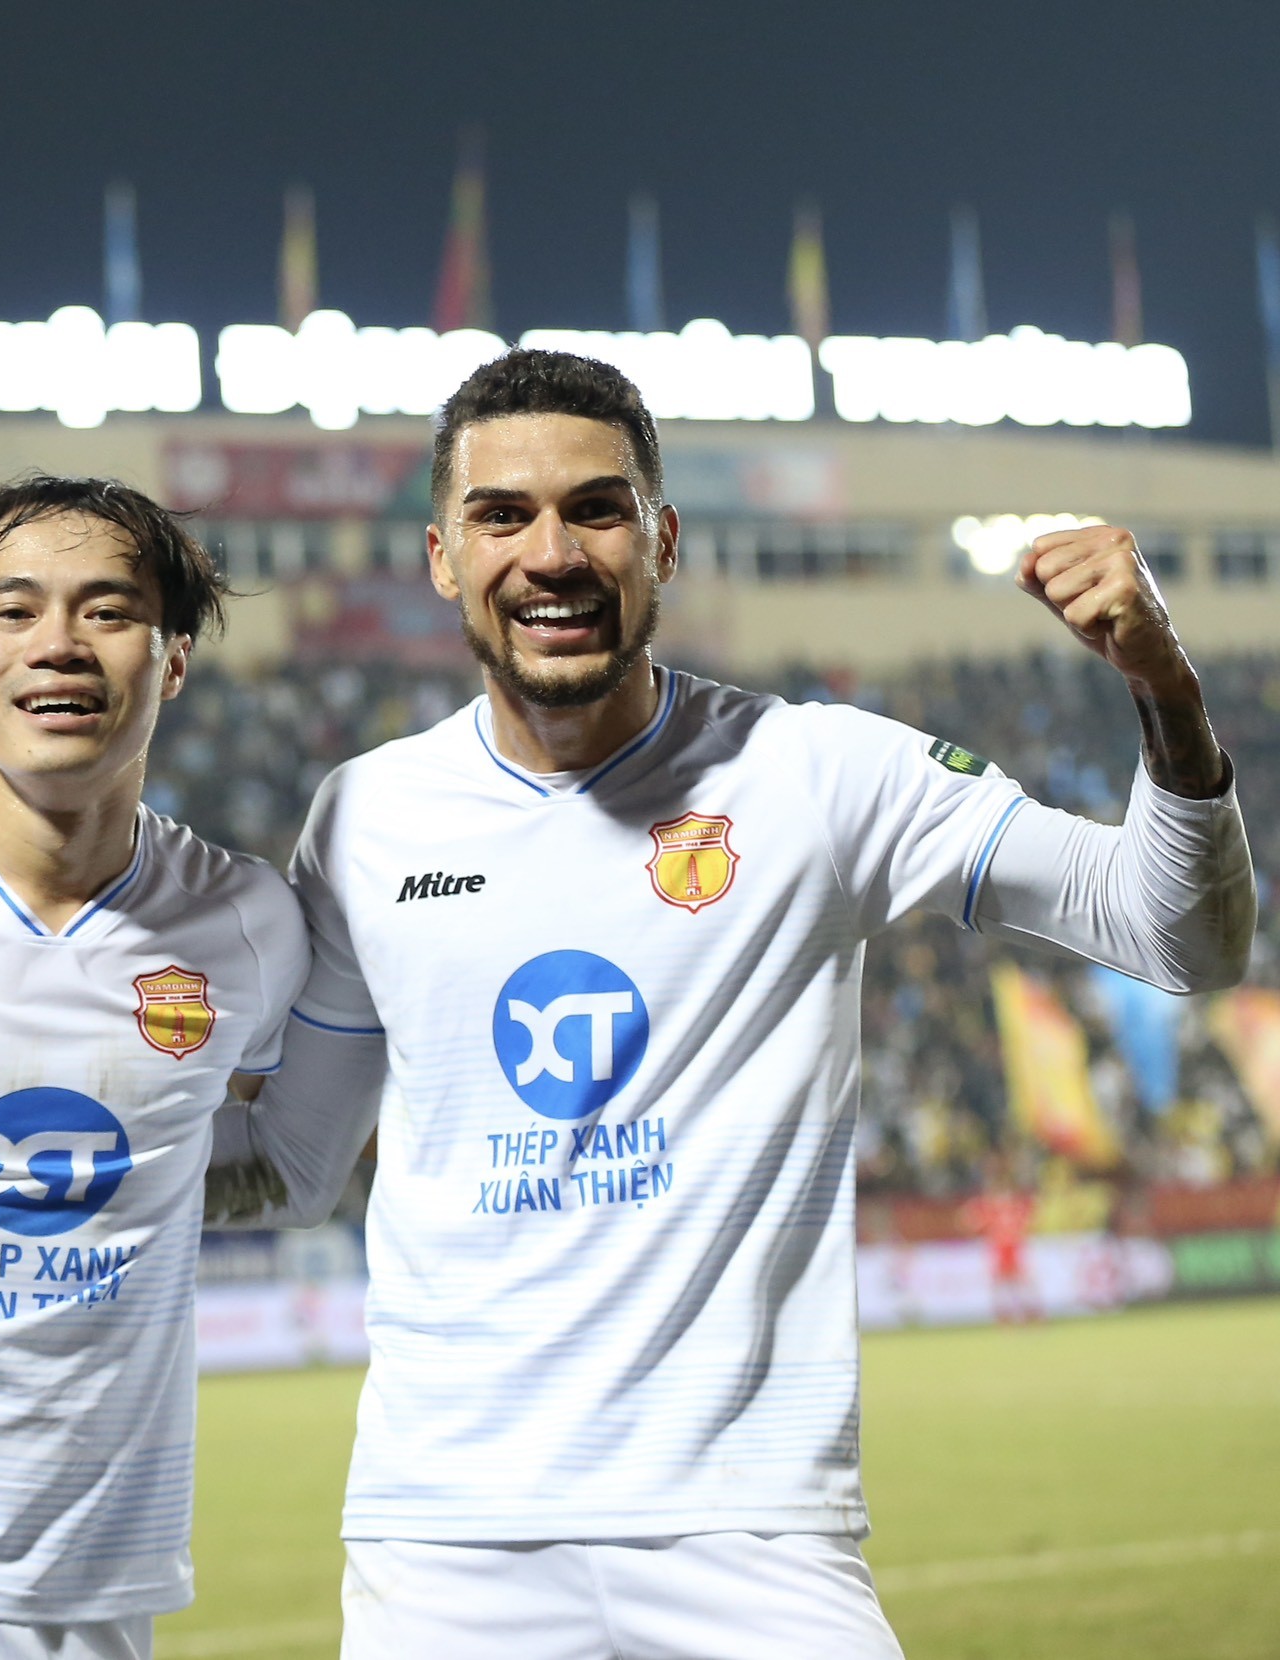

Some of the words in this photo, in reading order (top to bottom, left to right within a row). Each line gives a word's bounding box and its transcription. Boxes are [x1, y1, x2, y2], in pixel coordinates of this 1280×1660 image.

[396, 872, 486, 903] Mitre
[487, 1122, 559, 1168] THÉP
[569, 1117, 666, 1162] XANH
[472, 1170, 562, 1214] XUÂN
[570, 1160, 674, 1209] THIỆN
